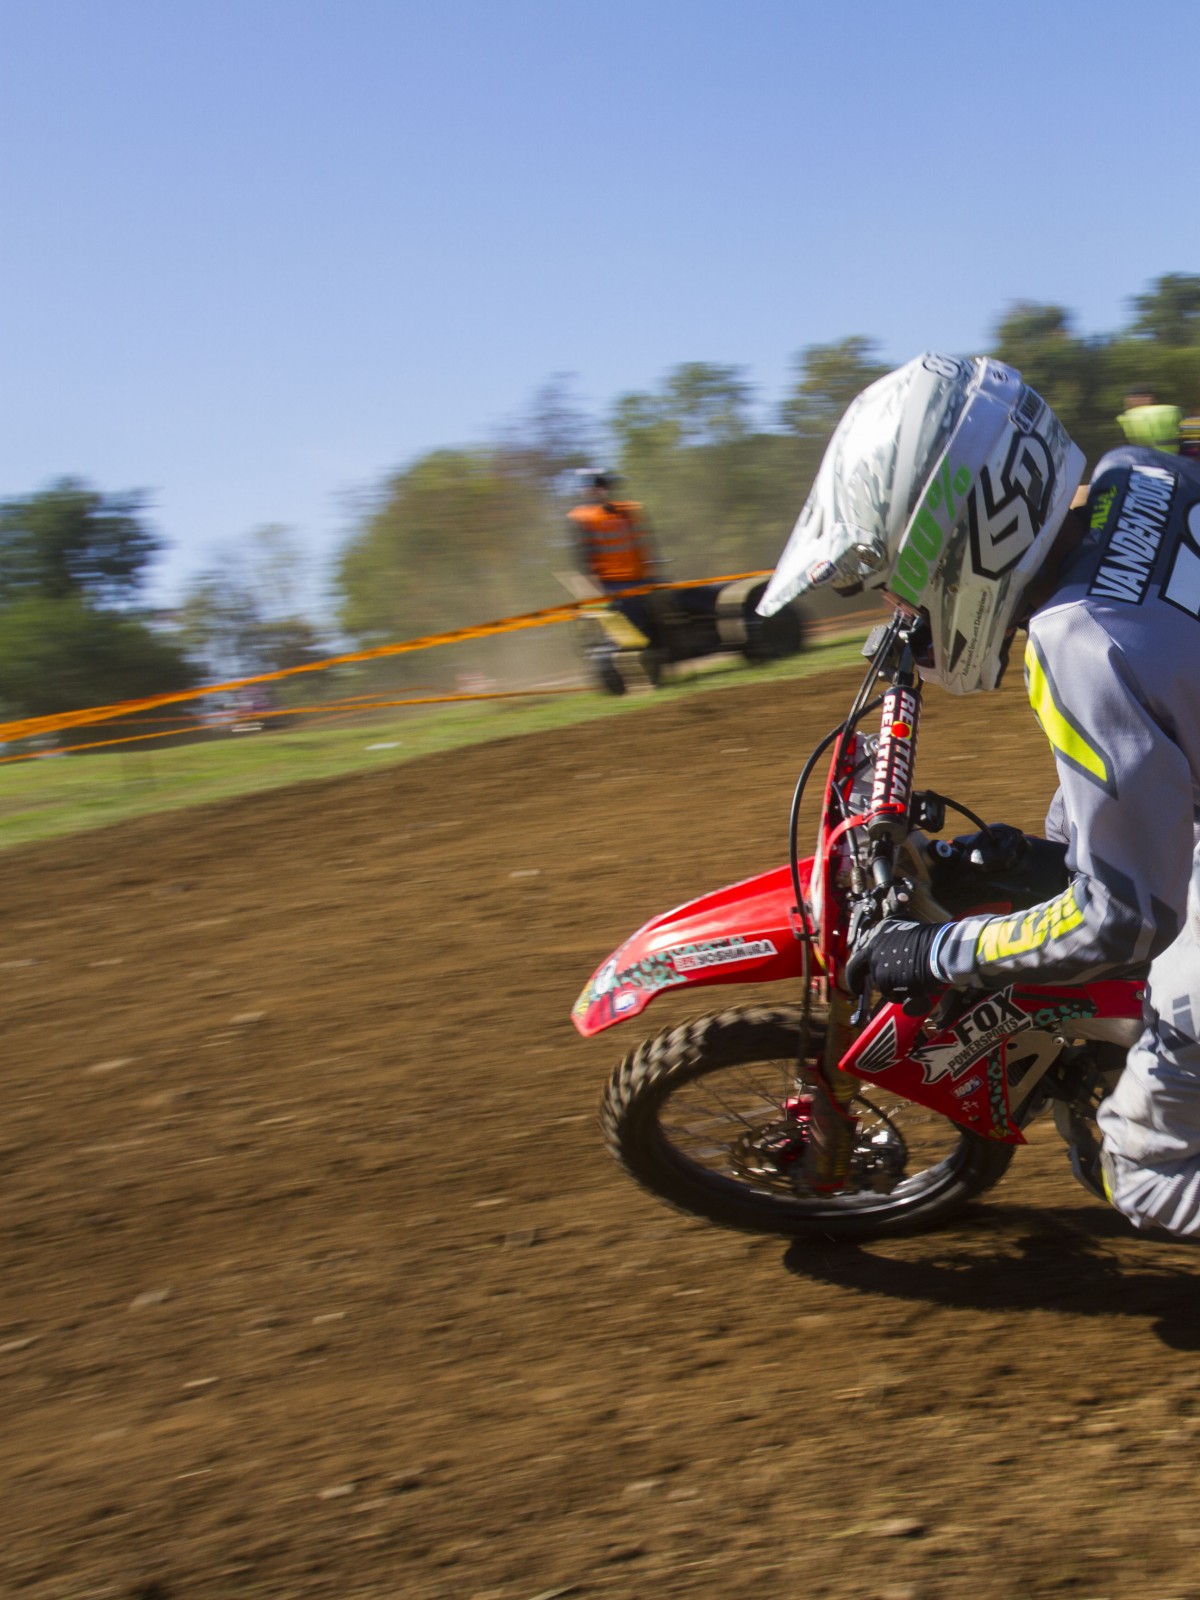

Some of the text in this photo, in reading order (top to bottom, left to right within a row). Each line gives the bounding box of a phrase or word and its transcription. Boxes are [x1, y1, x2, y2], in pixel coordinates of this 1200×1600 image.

[891, 455, 972, 606] 100%
[947, 1017, 1019, 1072] POWERSPORTS
[952, 987, 1030, 1047] FOX
[954, 1078, 981, 1099] 100%
